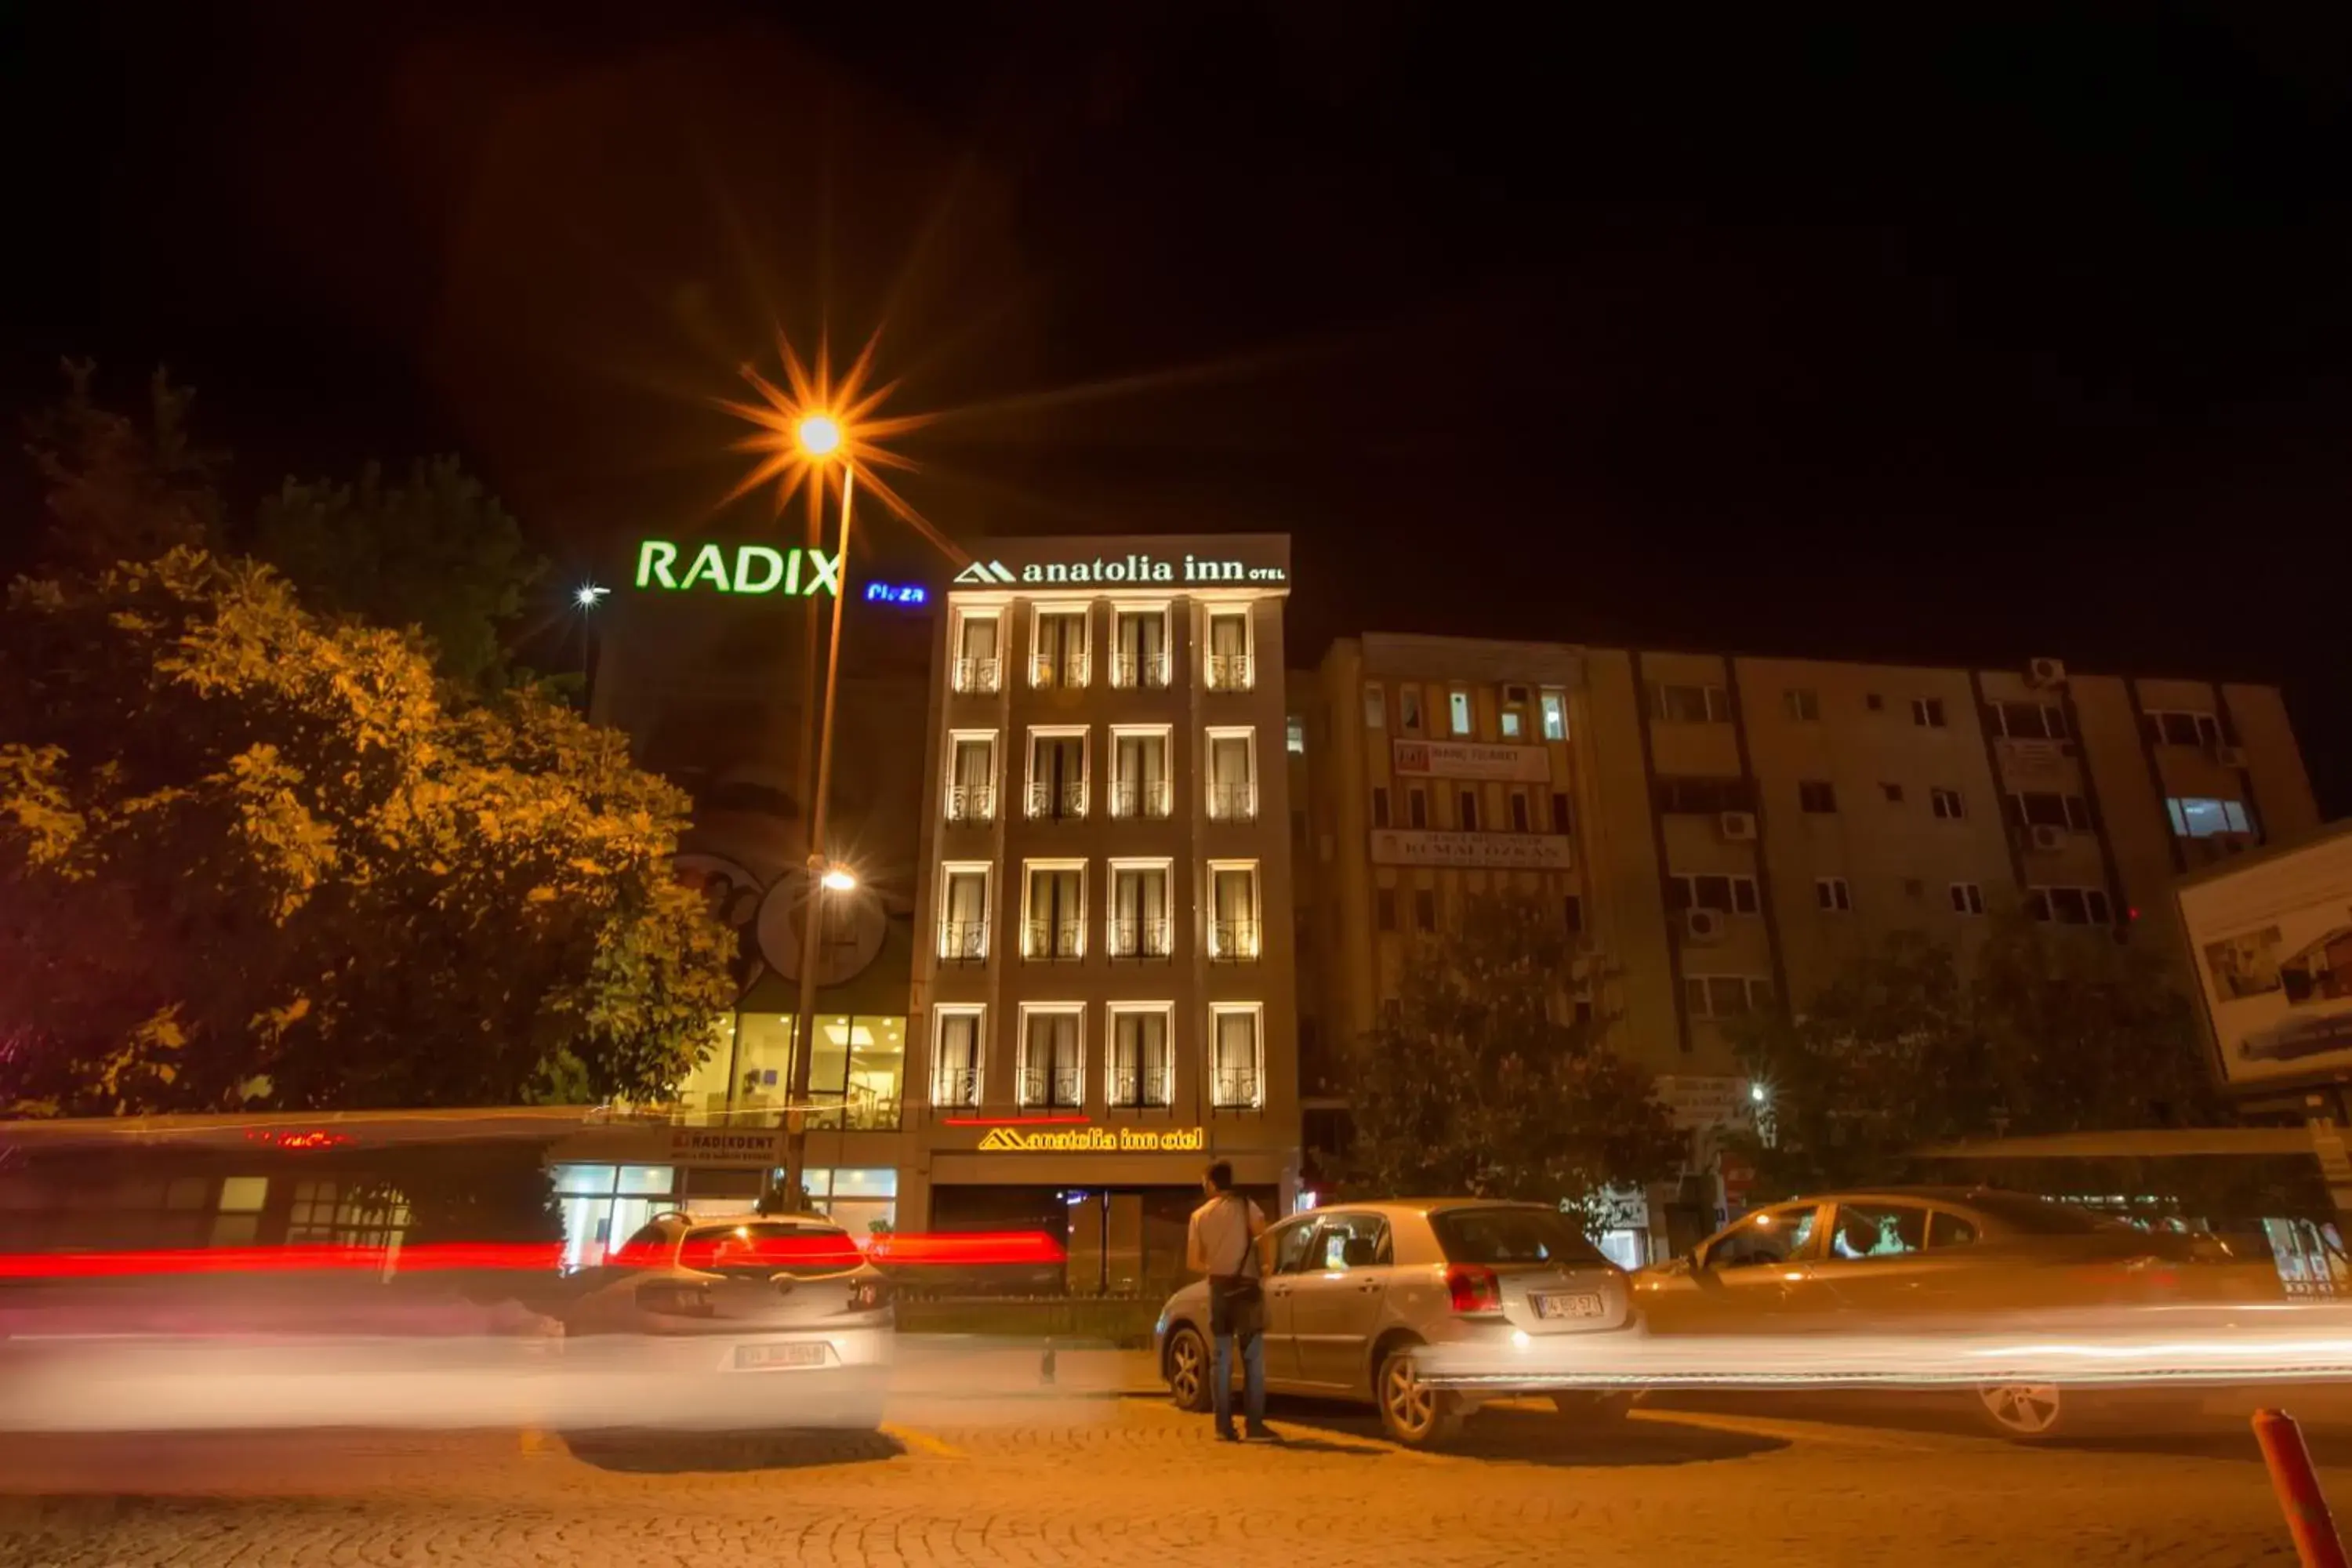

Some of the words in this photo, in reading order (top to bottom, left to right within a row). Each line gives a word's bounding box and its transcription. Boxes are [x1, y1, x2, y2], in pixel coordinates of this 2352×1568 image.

[635, 540, 841, 597] RADIX
[1022, 555, 1173, 582] anatolia
[1185, 554, 1243, 580] inn
[1249, 568, 1286, 580] OTEL
[1028, 1127, 1116, 1150] anatolia
[1120, 1127, 1158, 1150] inn
[1160, 1127, 1203, 1150] otel
